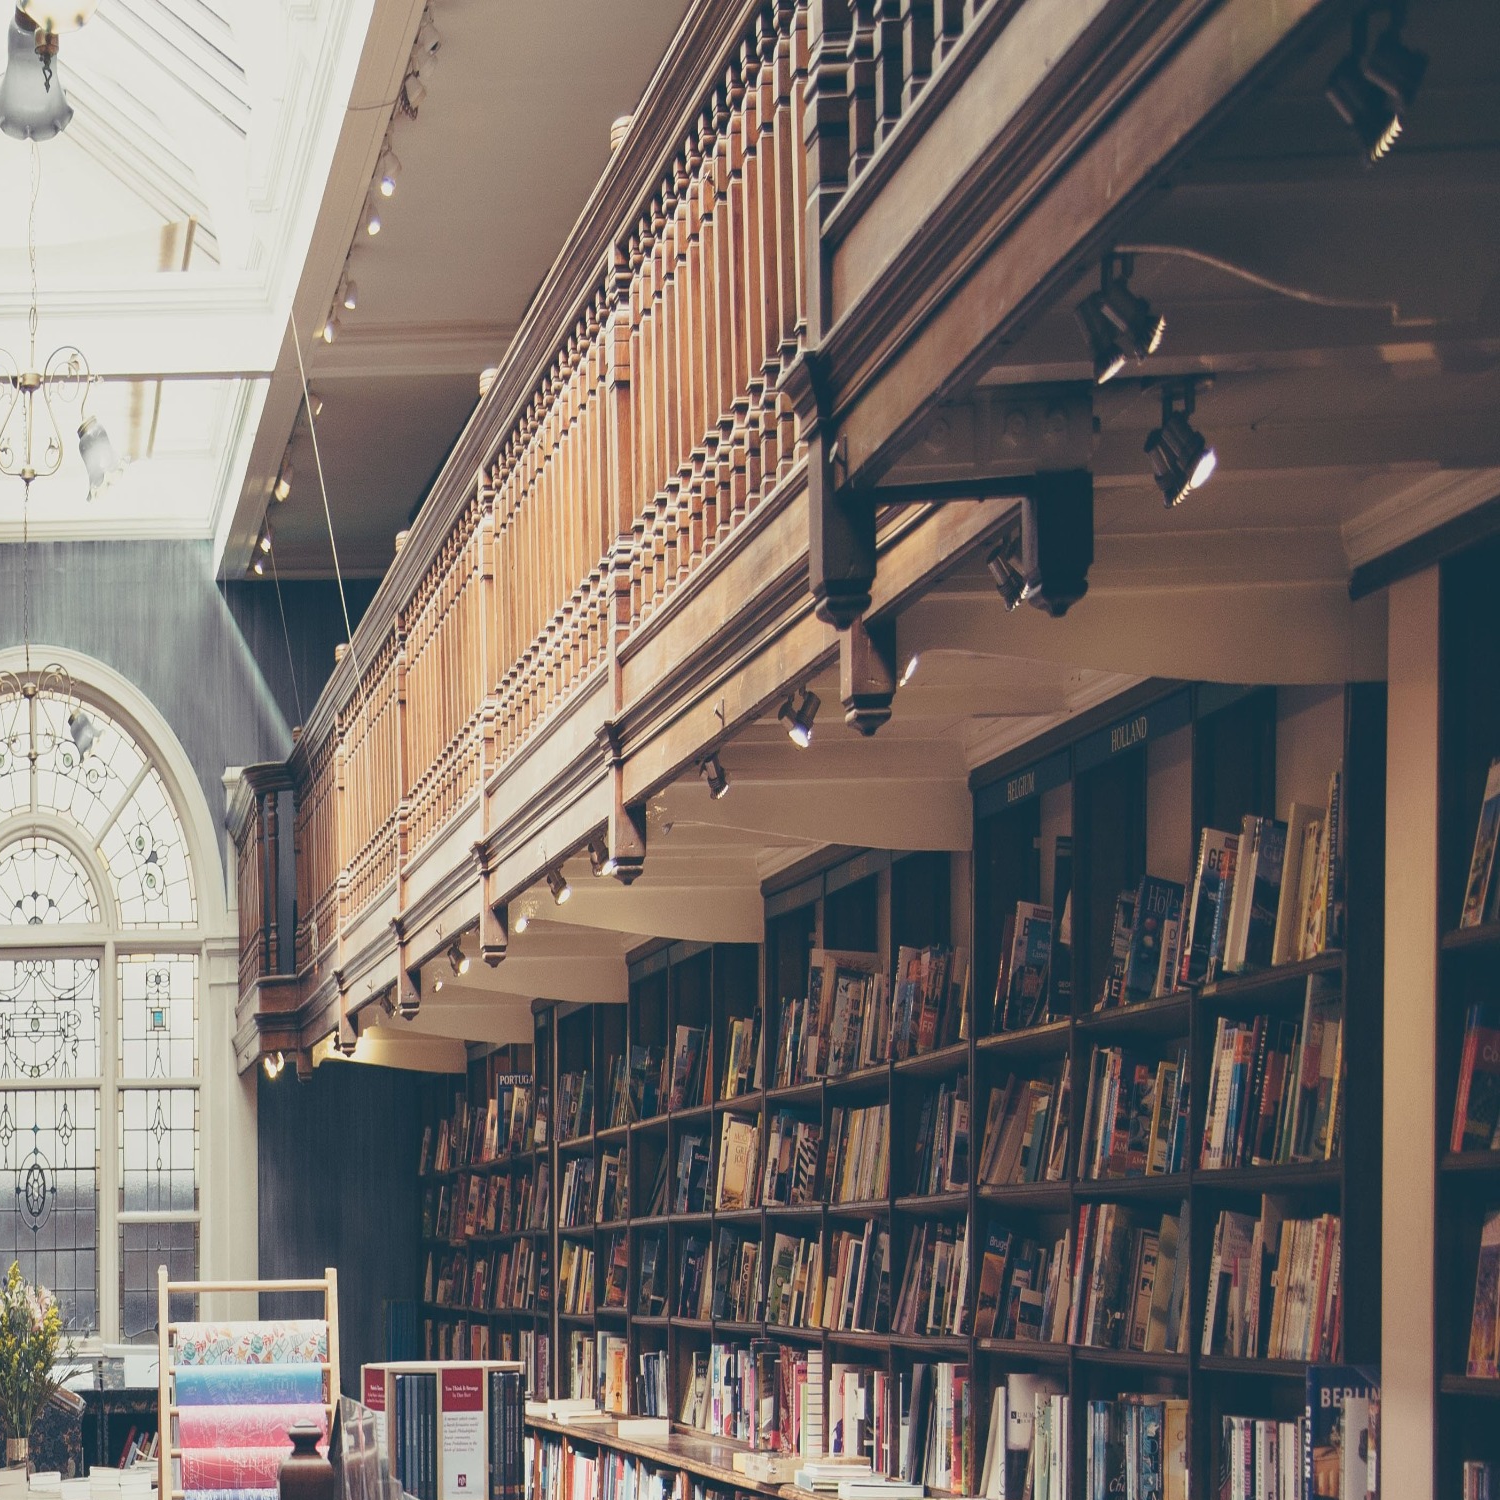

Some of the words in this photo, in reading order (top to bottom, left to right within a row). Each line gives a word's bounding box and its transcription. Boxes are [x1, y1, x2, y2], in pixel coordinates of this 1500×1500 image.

[1111, 715, 1148, 753] HOLLAND
[1007, 771, 1035, 803] BELGIUM
[1304, 1405, 1313, 1479] BERLIN
